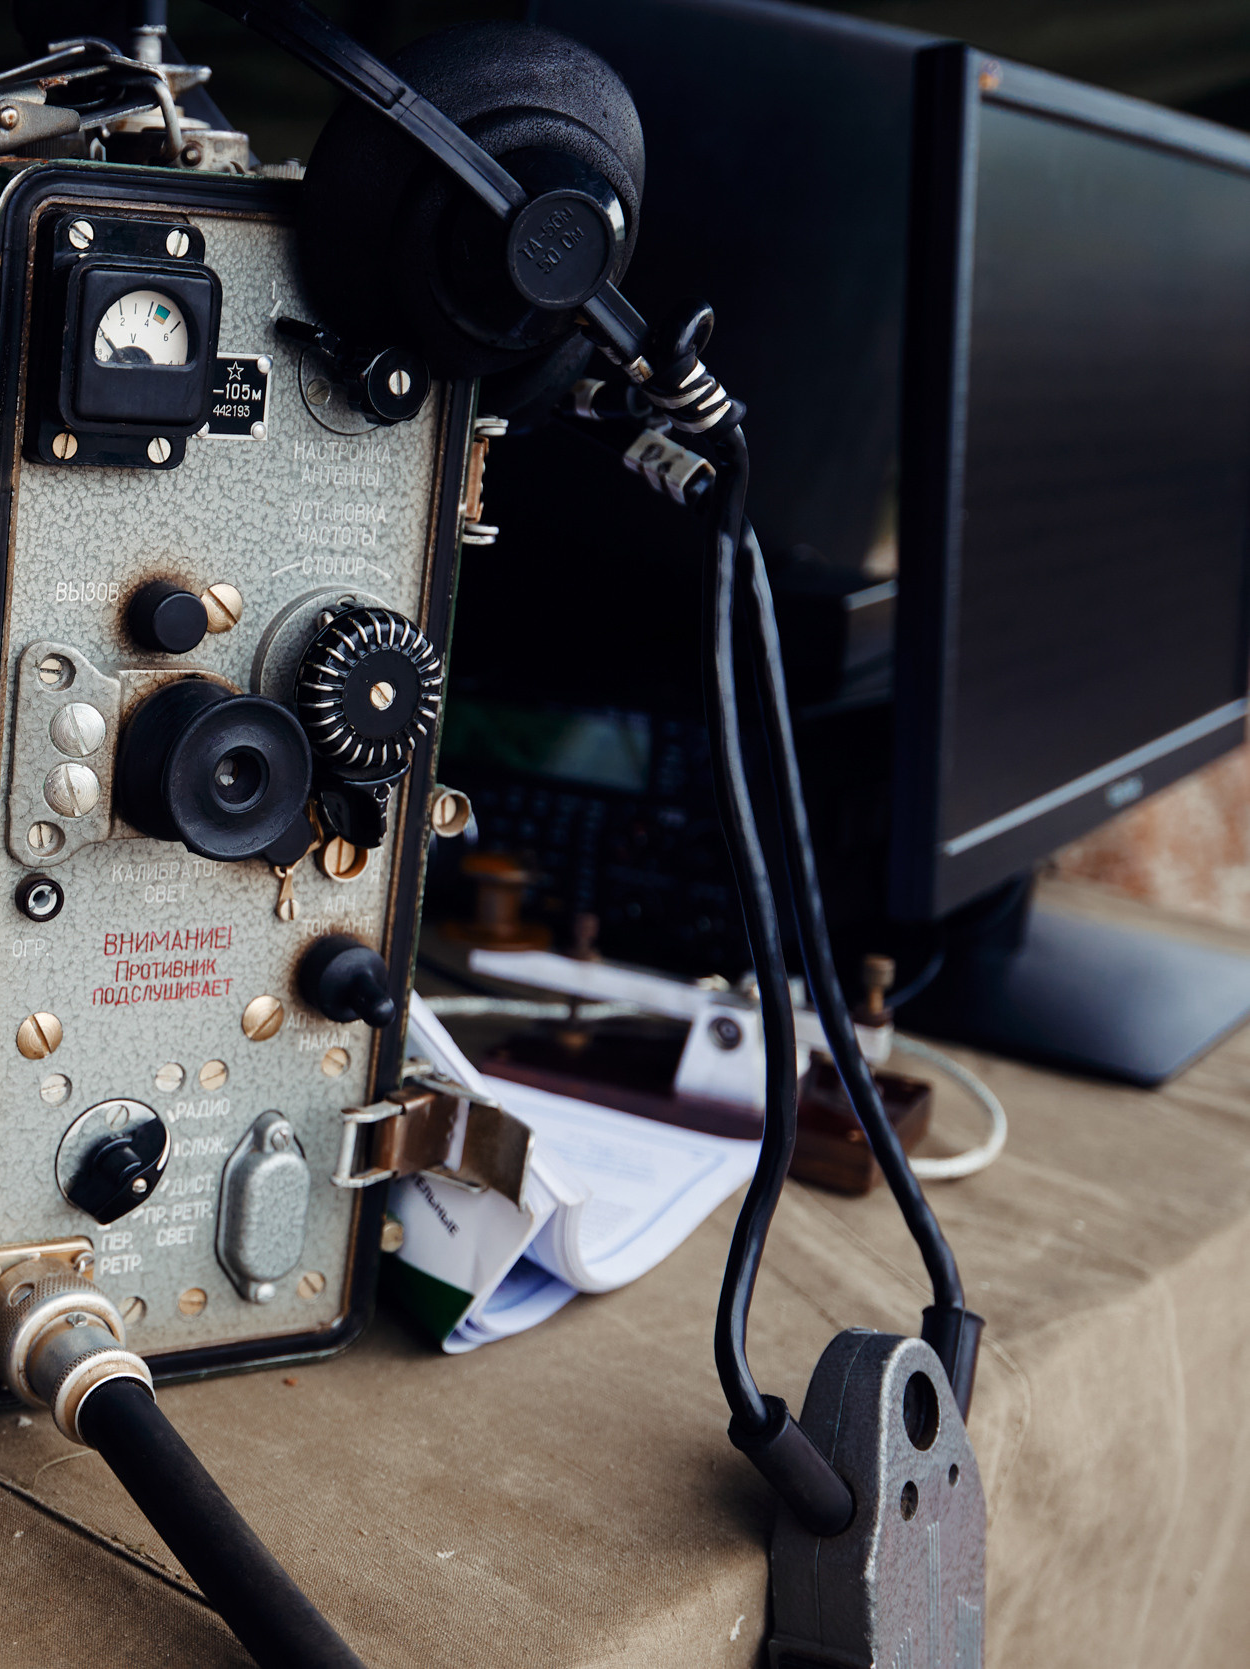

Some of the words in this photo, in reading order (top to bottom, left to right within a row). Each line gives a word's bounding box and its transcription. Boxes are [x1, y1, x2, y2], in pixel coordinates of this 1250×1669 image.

[119, 317, 126, 327] 2
[143, 318, 150, 328] 4
[130, 332, 137, 344] V
[163, 332, 169, 342] 6
[212, 403, 251, 418] 442193
[294, 439, 392, 463] НАСТРОЙКА
[301, 463, 381, 487] АНТЕННЫ
[292, 500, 387, 523] УСТАНОВКА
[297, 524, 378, 546] ЧАСТОТЫ
[302, 555, 366, 576] СТОПОР
[55, 581, 120, 603] ВЫЗОВ
[111, 860, 224, 883] КАЛИБРАТОР
[144, 883, 190, 904] СВЕТ
[324, 894, 357, 914] АПЧ
[301, 919, 332, 937] ТОК
[103, 925, 233, 956] ВНИМАНИЕ!
[92, 978, 235, 1007] ПОДСЛУШИВАЕТ
[174, 1098, 231, 1120] РАДИО
[155, 1225, 198, 1247] СВЕТ
